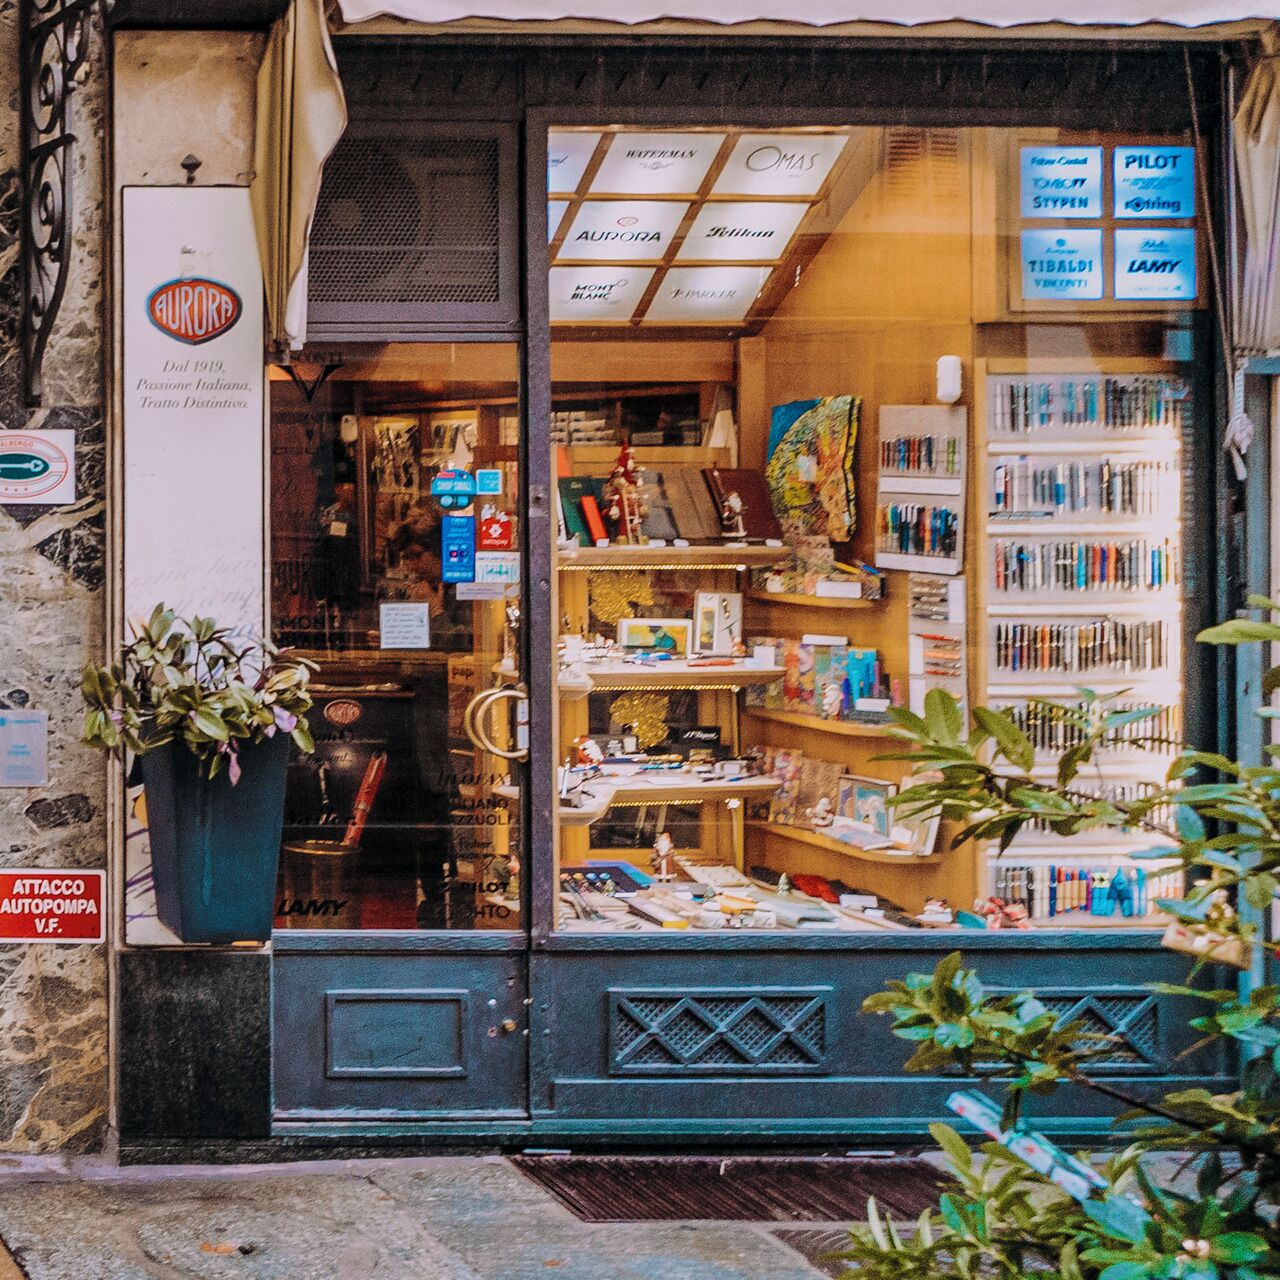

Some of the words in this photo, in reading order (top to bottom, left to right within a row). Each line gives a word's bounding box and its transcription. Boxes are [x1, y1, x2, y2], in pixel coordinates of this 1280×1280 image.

[625, 149, 699, 159] WATERMAN
[1125, 154, 1181, 169] PILOT
[1033, 195, 1089, 209] STYPEN
[575, 230, 662, 242] AURORA
[706, 226, 776, 238] Pelikan
[1028, 259, 1093, 273] TIBALDI
[1126, 259, 1182, 273] LAMY
[575, 284, 618, 292] MONT
[155, 286, 233, 337] AURORA
[162, 360, 190, 372] Dal
[137, 379, 191, 391] Passione
[195, 379, 253, 393] Italiana,
[141, 396, 181, 409] Tratto
[184, 397, 249, 410] Distintivo.
[12, 879, 85, 895] ATTACCO
[0, 898, 97, 915] AUTOPOMPA
[277, 898, 348, 918] LAMY
[34, 919, 63, 933] V.F.
